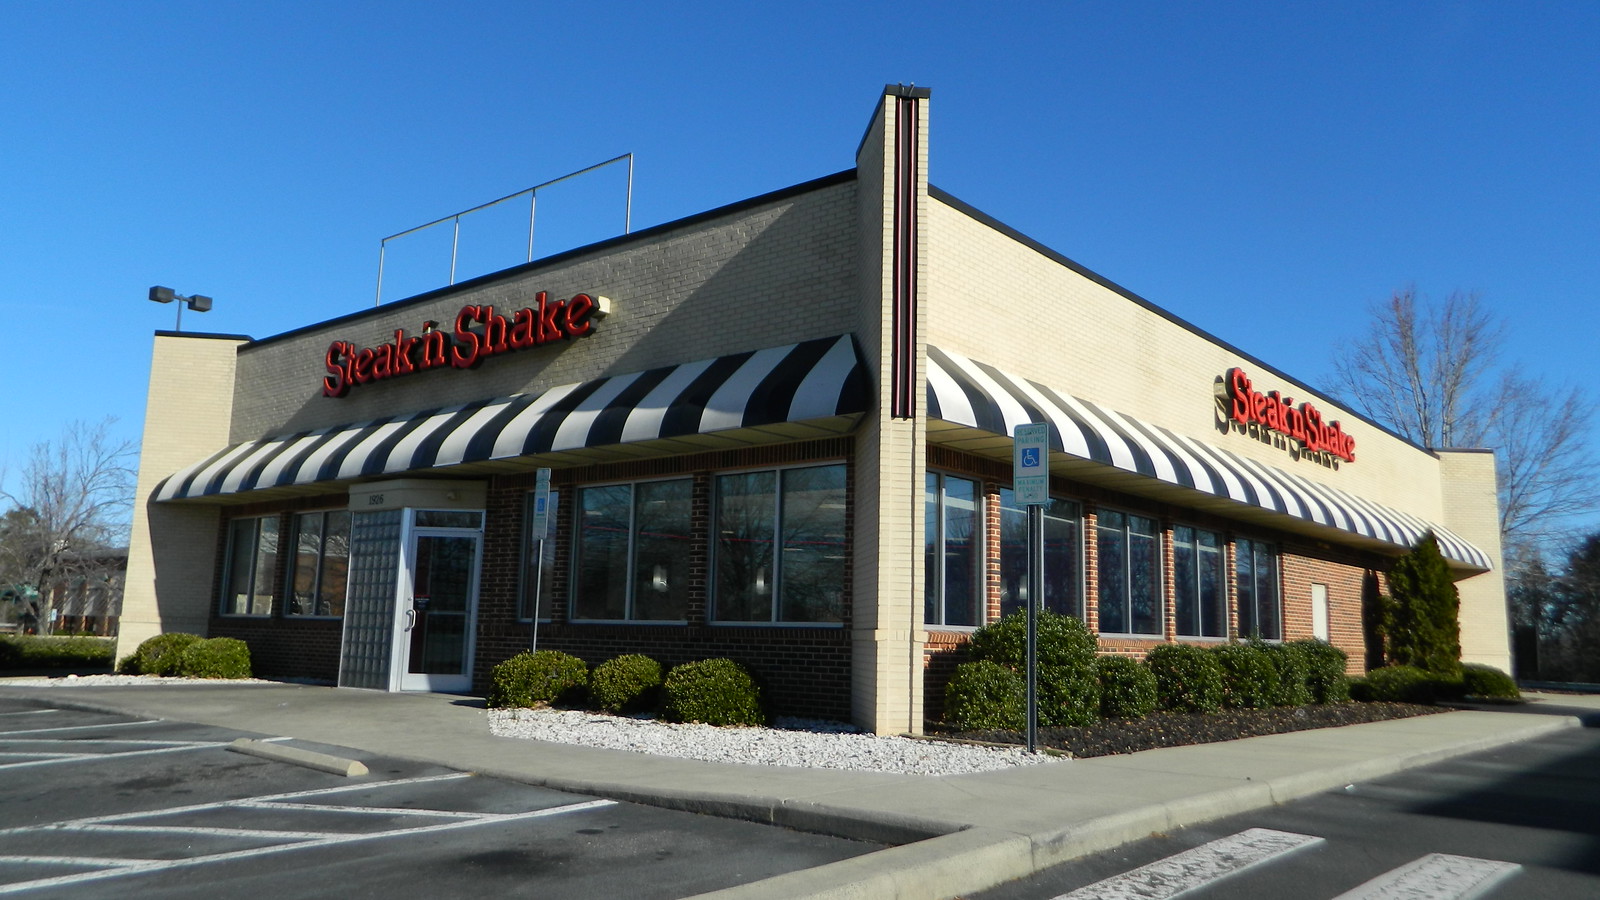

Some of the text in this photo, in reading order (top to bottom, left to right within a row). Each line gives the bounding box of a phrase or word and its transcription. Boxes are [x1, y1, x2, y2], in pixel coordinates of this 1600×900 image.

[322, 328, 418, 398] Steak
[451, 290, 594, 368] Shake
[1017, 435, 1046, 444] PARKING
[1231, 366, 1291, 434] Steak
[1306, 401, 1356, 463] Shake
